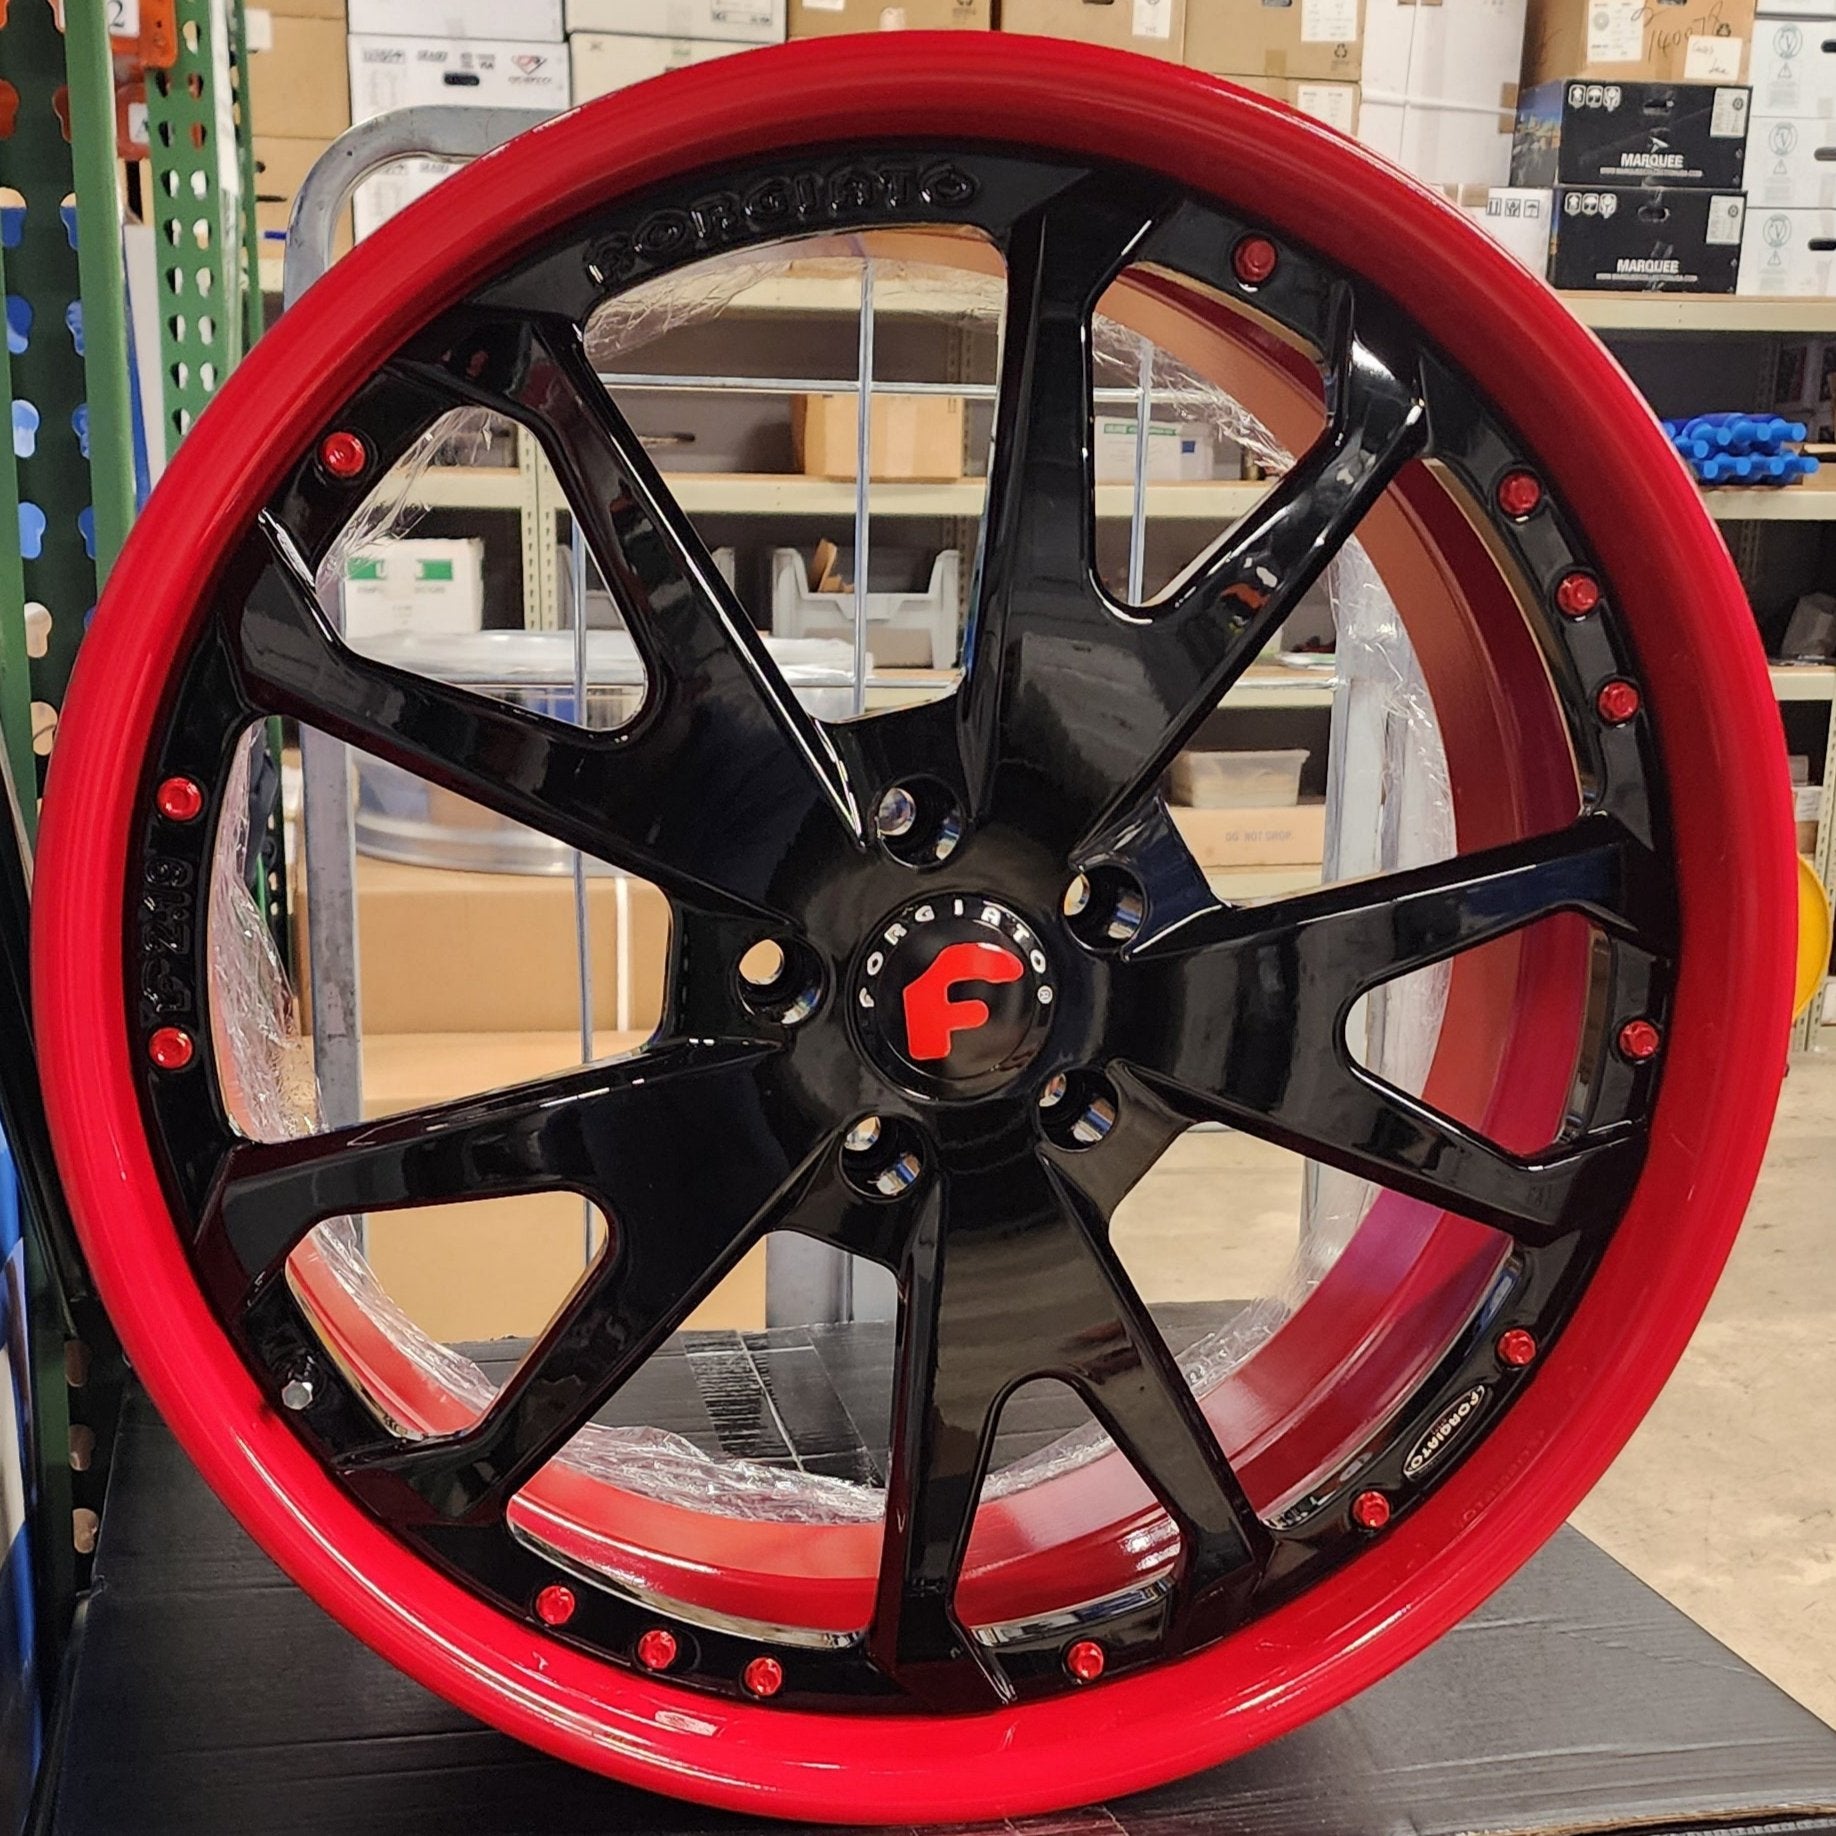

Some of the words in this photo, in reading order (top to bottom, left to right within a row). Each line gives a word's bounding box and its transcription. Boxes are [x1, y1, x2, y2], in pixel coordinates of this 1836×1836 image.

[1620, 152, 1685, 169] MARQUEE
[582, 162, 981, 288] FORGIATO
[1616, 258, 1680, 274] MARQUEE
[859, 898, 1047, 1008] FORGIATO
[903, 942, 1024, 1060] F
[1410, 1390, 1480, 1470] FORGIATO
